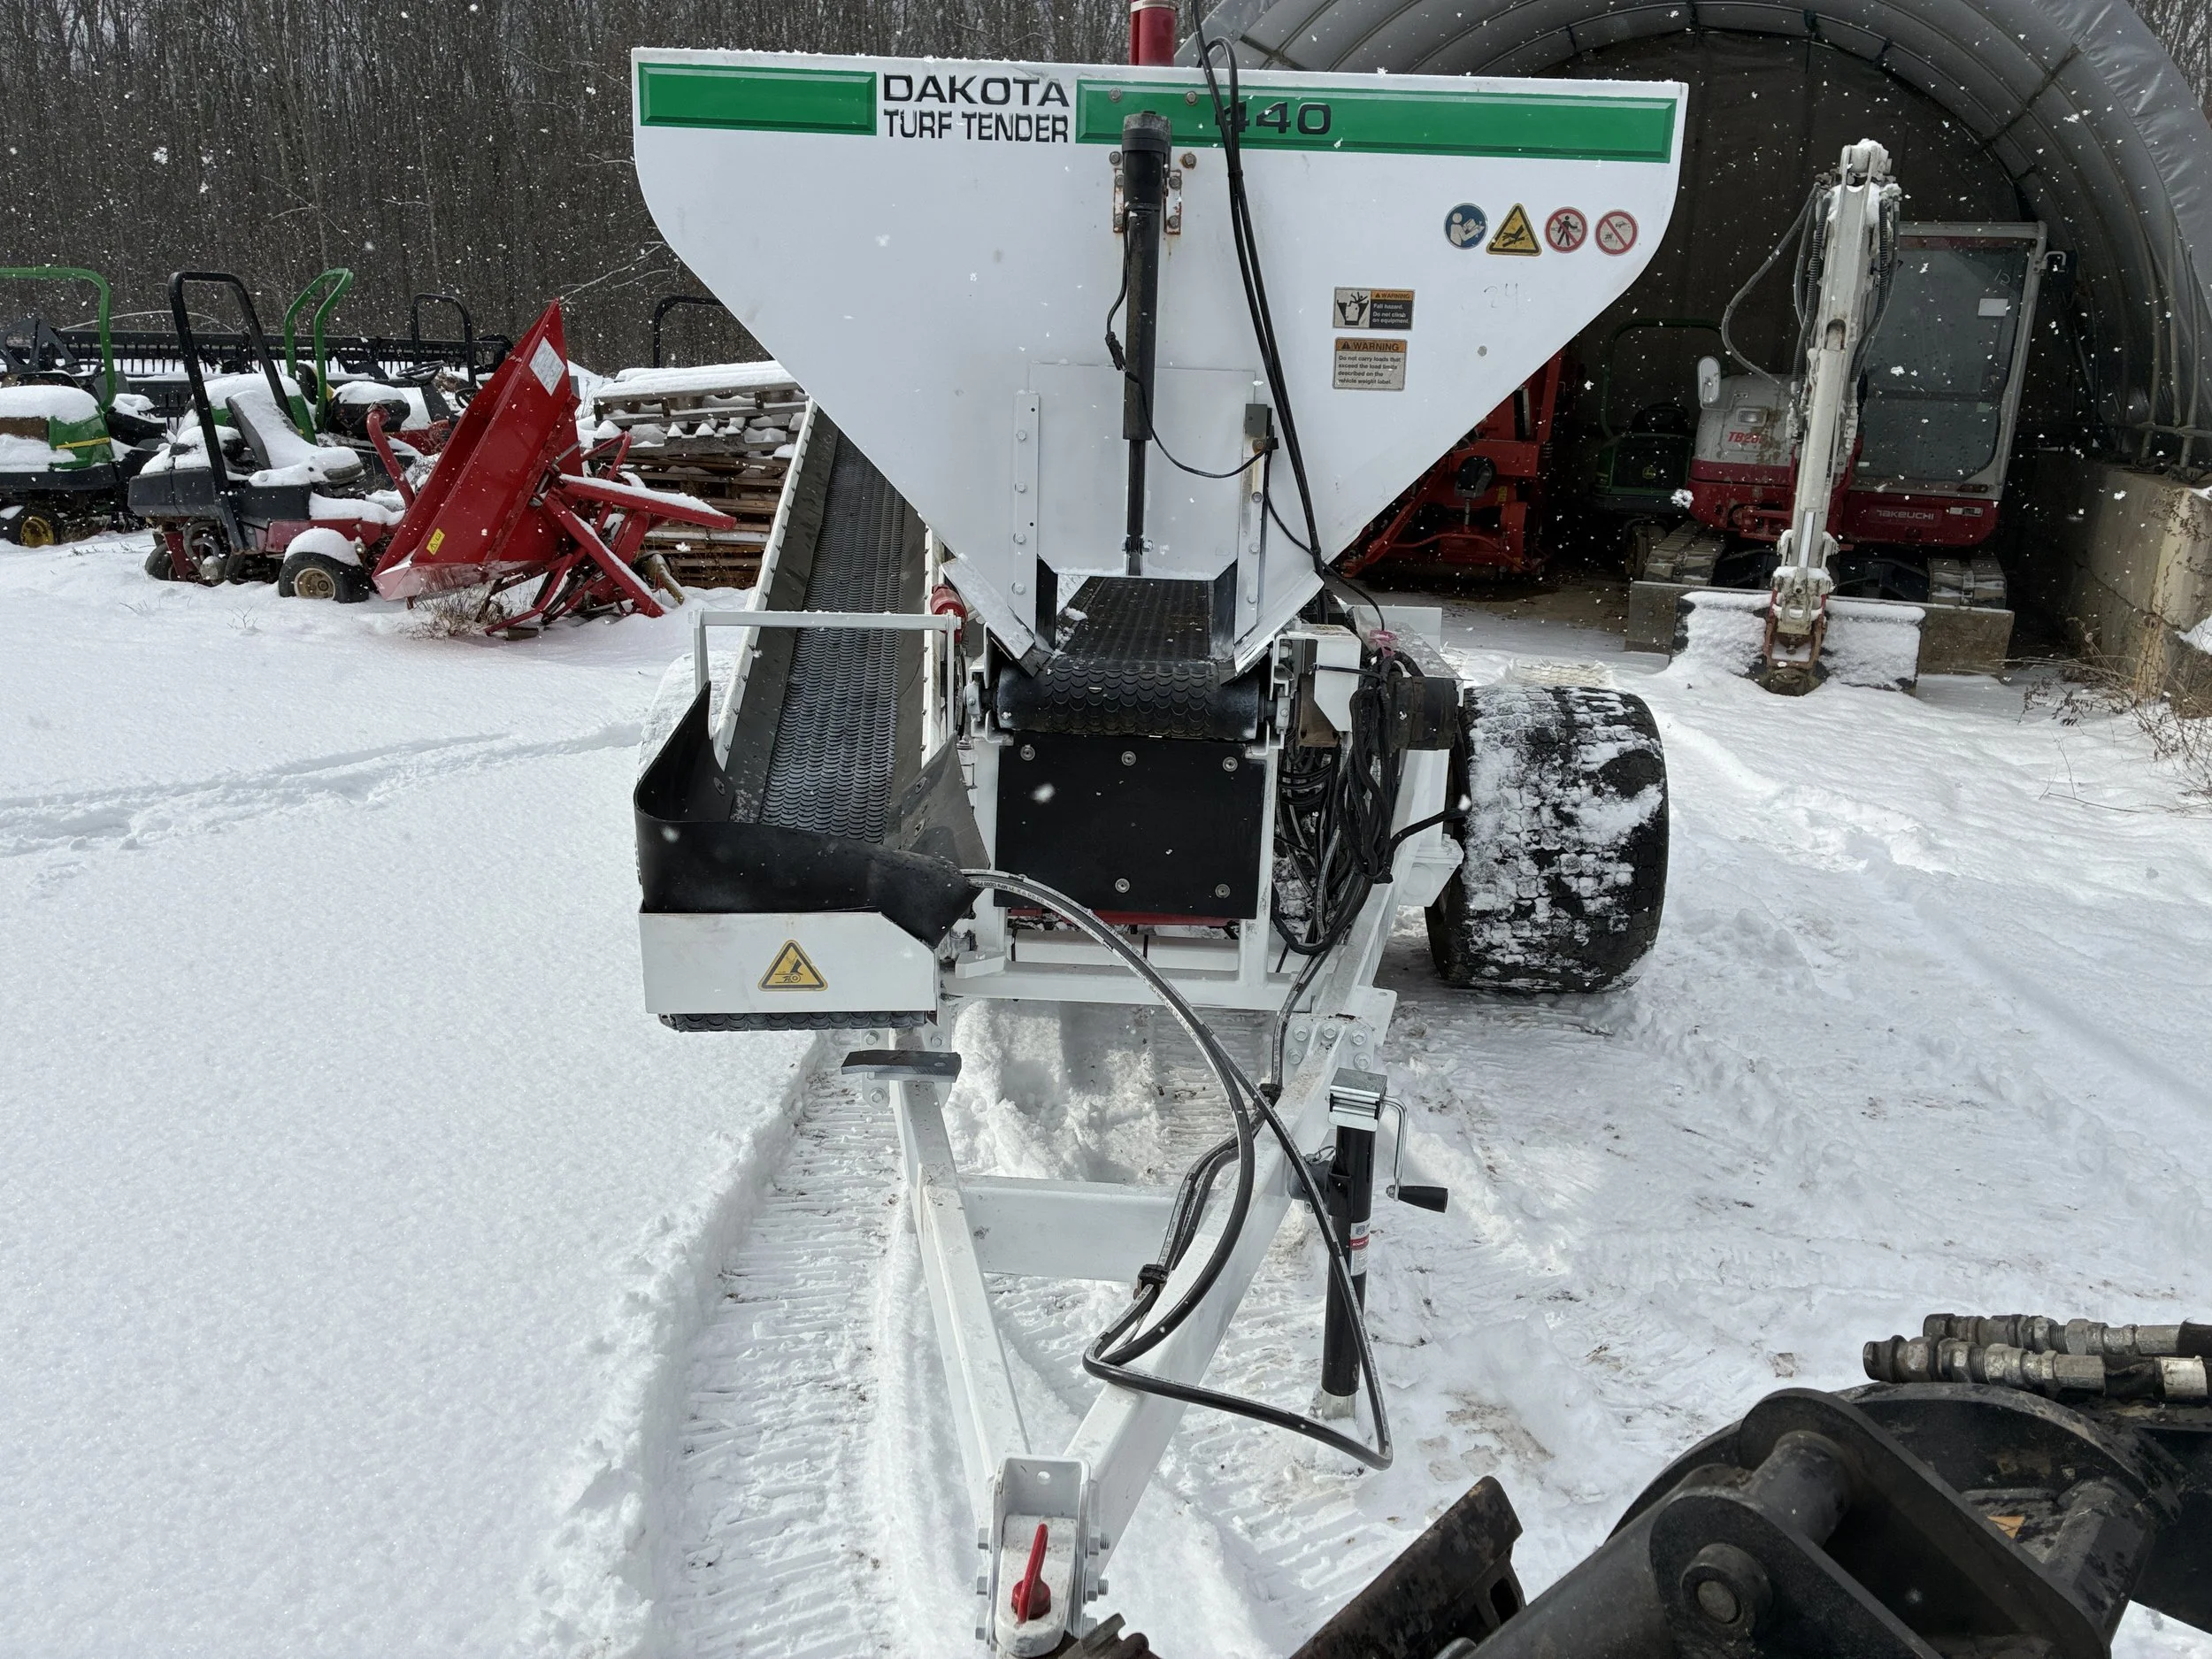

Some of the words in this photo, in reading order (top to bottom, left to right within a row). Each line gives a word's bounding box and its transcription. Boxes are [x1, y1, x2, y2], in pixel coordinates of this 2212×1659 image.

[884, 74, 1070, 107] DAKOTA
[883, 108, 953, 139] TURF
[961, 111, 1069, 143] TENDER
[1353, 342, 1400, 351] WARNING
[1877, 509, 1934, 520] TAKEUCHI
